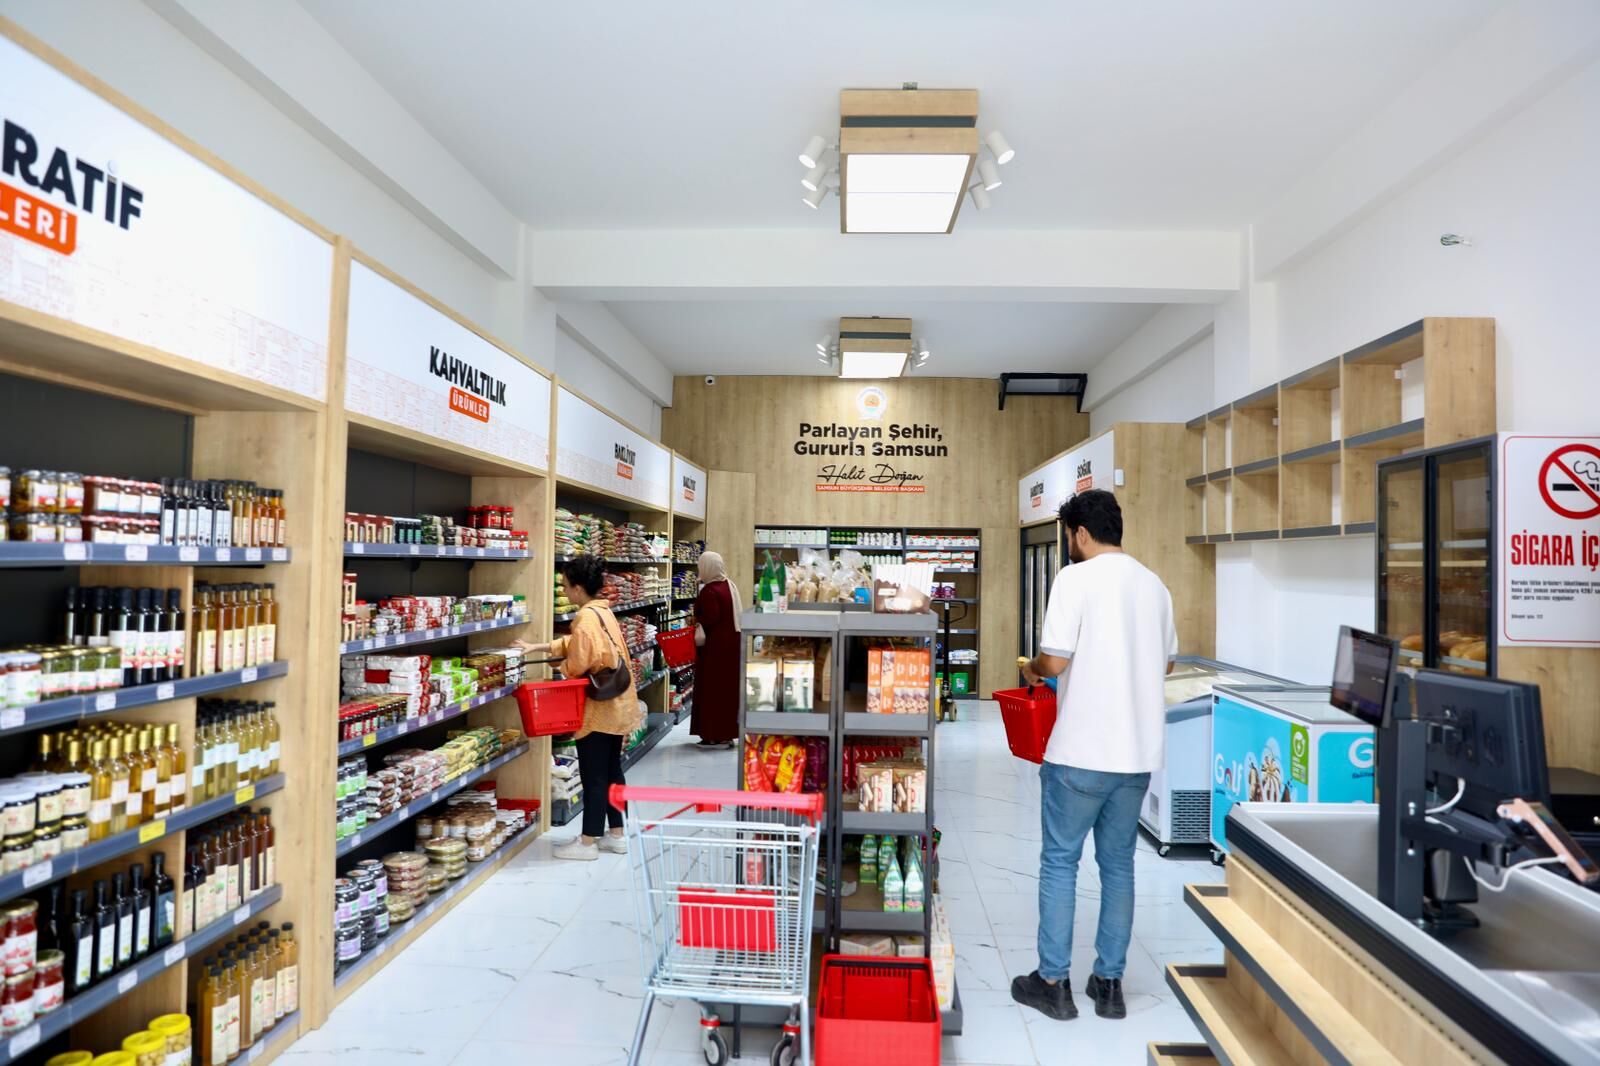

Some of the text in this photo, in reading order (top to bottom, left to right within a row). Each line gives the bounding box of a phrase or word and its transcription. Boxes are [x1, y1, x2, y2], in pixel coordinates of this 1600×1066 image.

[2, 118, 144, 231] RATİF
[429, 345, 507, 407] KAHVALTILIK
[452, 389, 488, 418] ÜRÜNLER
[794, 441, 948, 457] Gururla Samsun
[800, 423, 943, 441] Parlayan Şehir,
[817, 463, 924, 487] Halit Doğan
[1511, 529, 1600, 572] SİGARA İÇ
[1215, 752, 1243, 796] Golf
